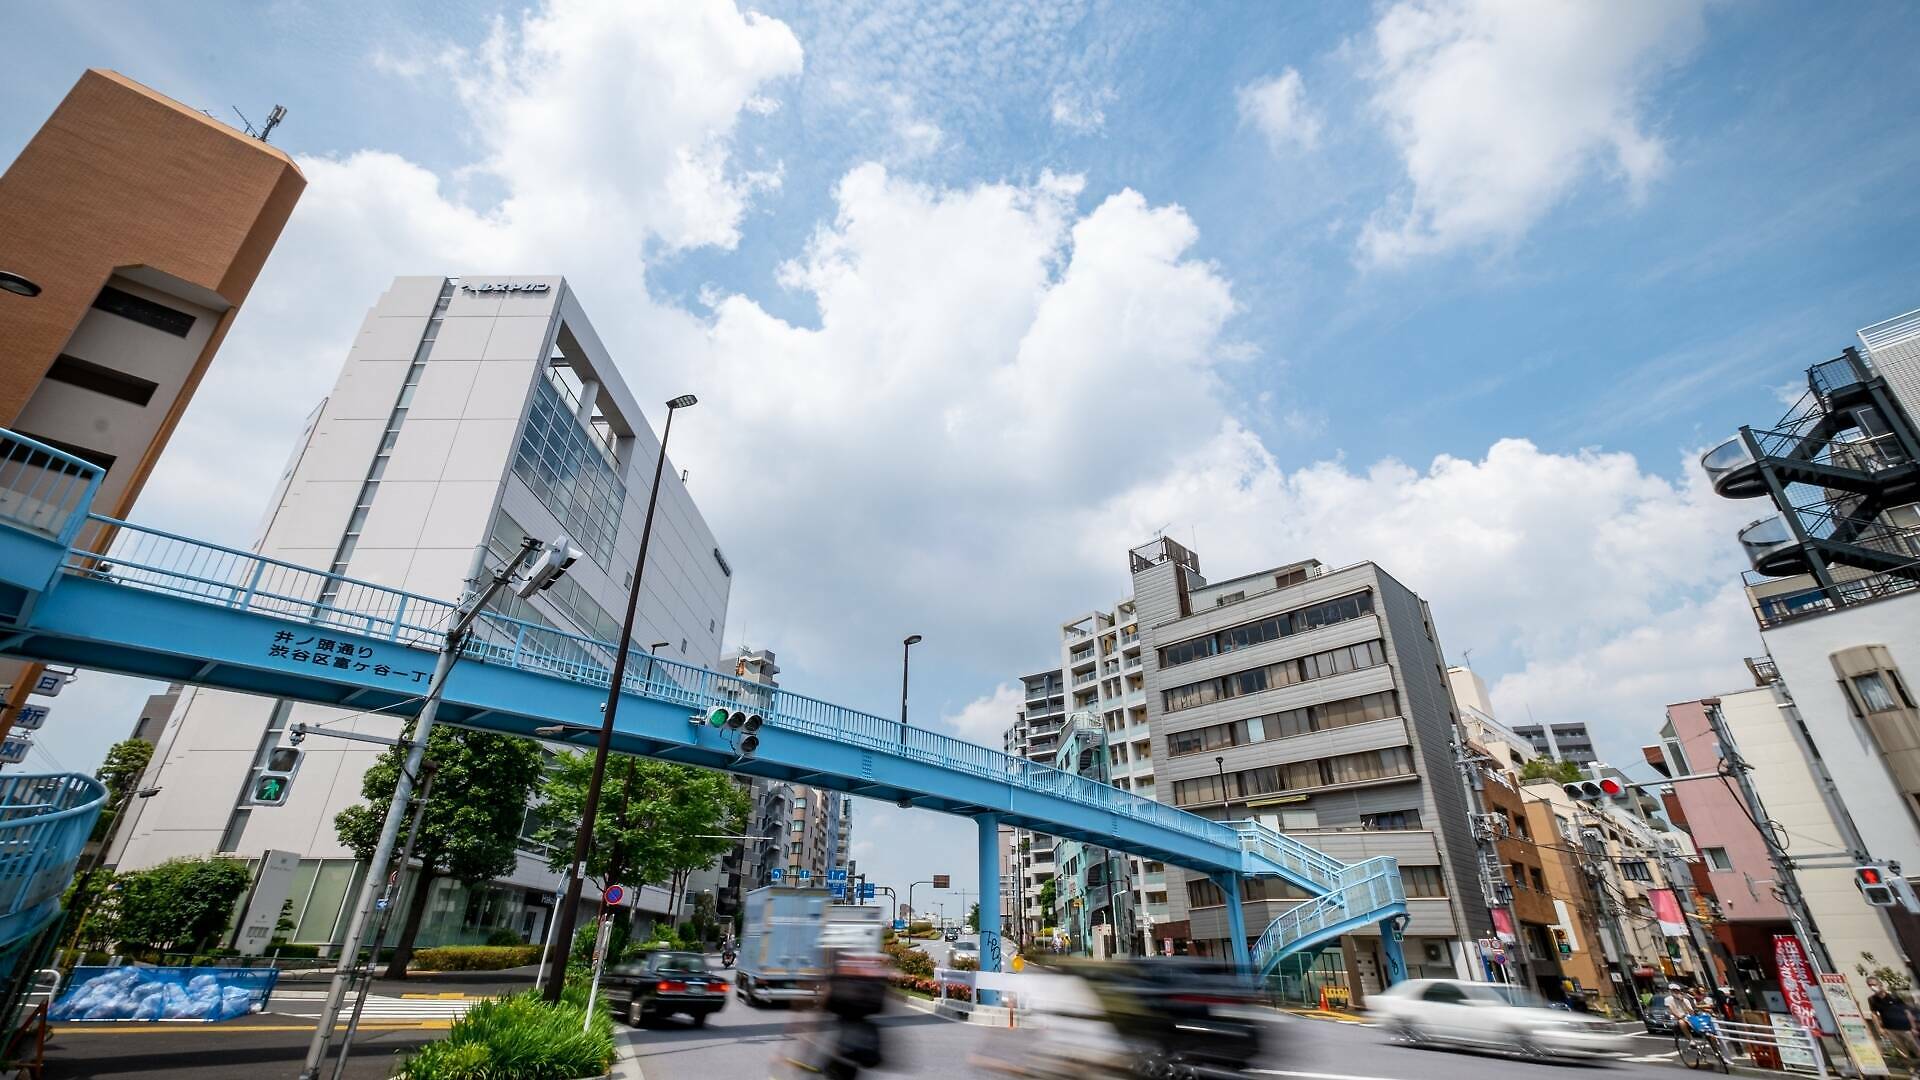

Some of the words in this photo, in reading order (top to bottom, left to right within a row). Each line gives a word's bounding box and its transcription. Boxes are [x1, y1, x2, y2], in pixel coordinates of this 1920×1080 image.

[274, 630, 373, 659] 井ノ頭通り
